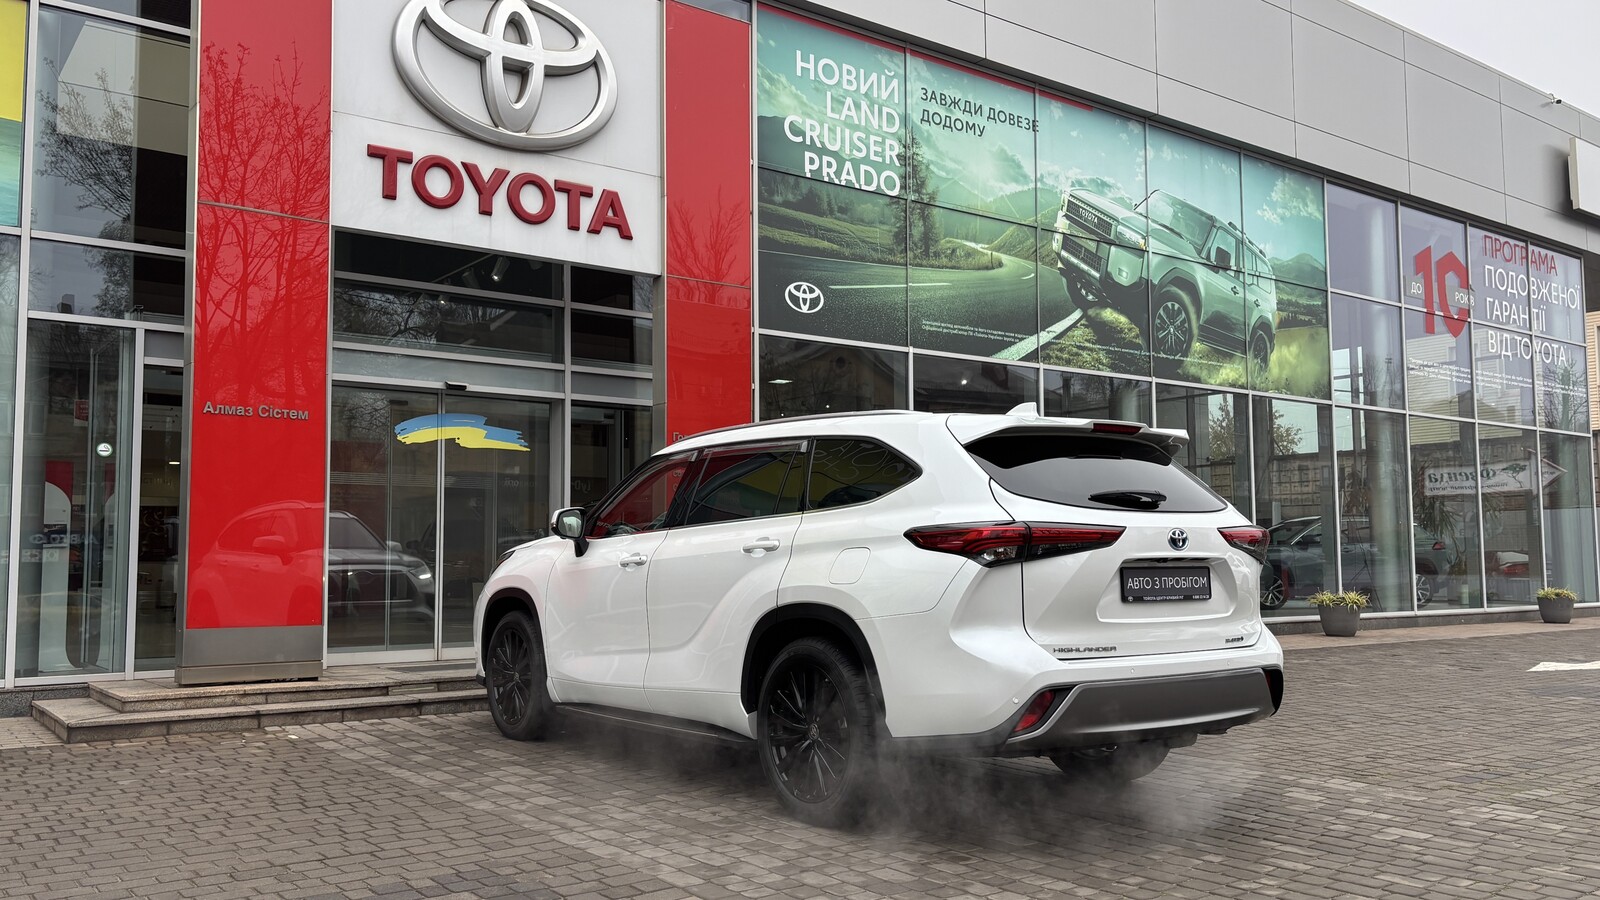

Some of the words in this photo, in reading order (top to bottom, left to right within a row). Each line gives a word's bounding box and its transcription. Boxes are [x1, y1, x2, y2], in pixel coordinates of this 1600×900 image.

[796, 49, 899, 104] НОВИЙ
[826, 90, 900, 133] LAND
[920, 87, 983, 117] ЗАВЖДИ
[987, 107, 1040, 132] ДОВЕЗЕ
[920, 108, 986, 137] ДОДОМУ
[783, 114, 901, 166] CRUISER
[367, 144, 633, 240] TOYOTA
[804, 151, 900, 196] PRADO
[1079, 208, 1098, 224] TOYOTA
[1484, 234, 1558, 277] ПРОГРАМА
[1411, 282, 1423, 295] ДО
[1484, 264, 1581, 311] ПОДОВЖЕНОЇ
[1486, 297, 1546, 332] ГАРАНТІЇ
[1488, 330, 1512, 361] ВІД
[203, 401, 253, 417] Алмаз
[258, 405, 309, 420] Сістем
[1127, 577, 1152, 590] АВТО
[1154, 577, 1160, 589] З
[1161, 576, 1208, 589] ПРОБІГОМ
